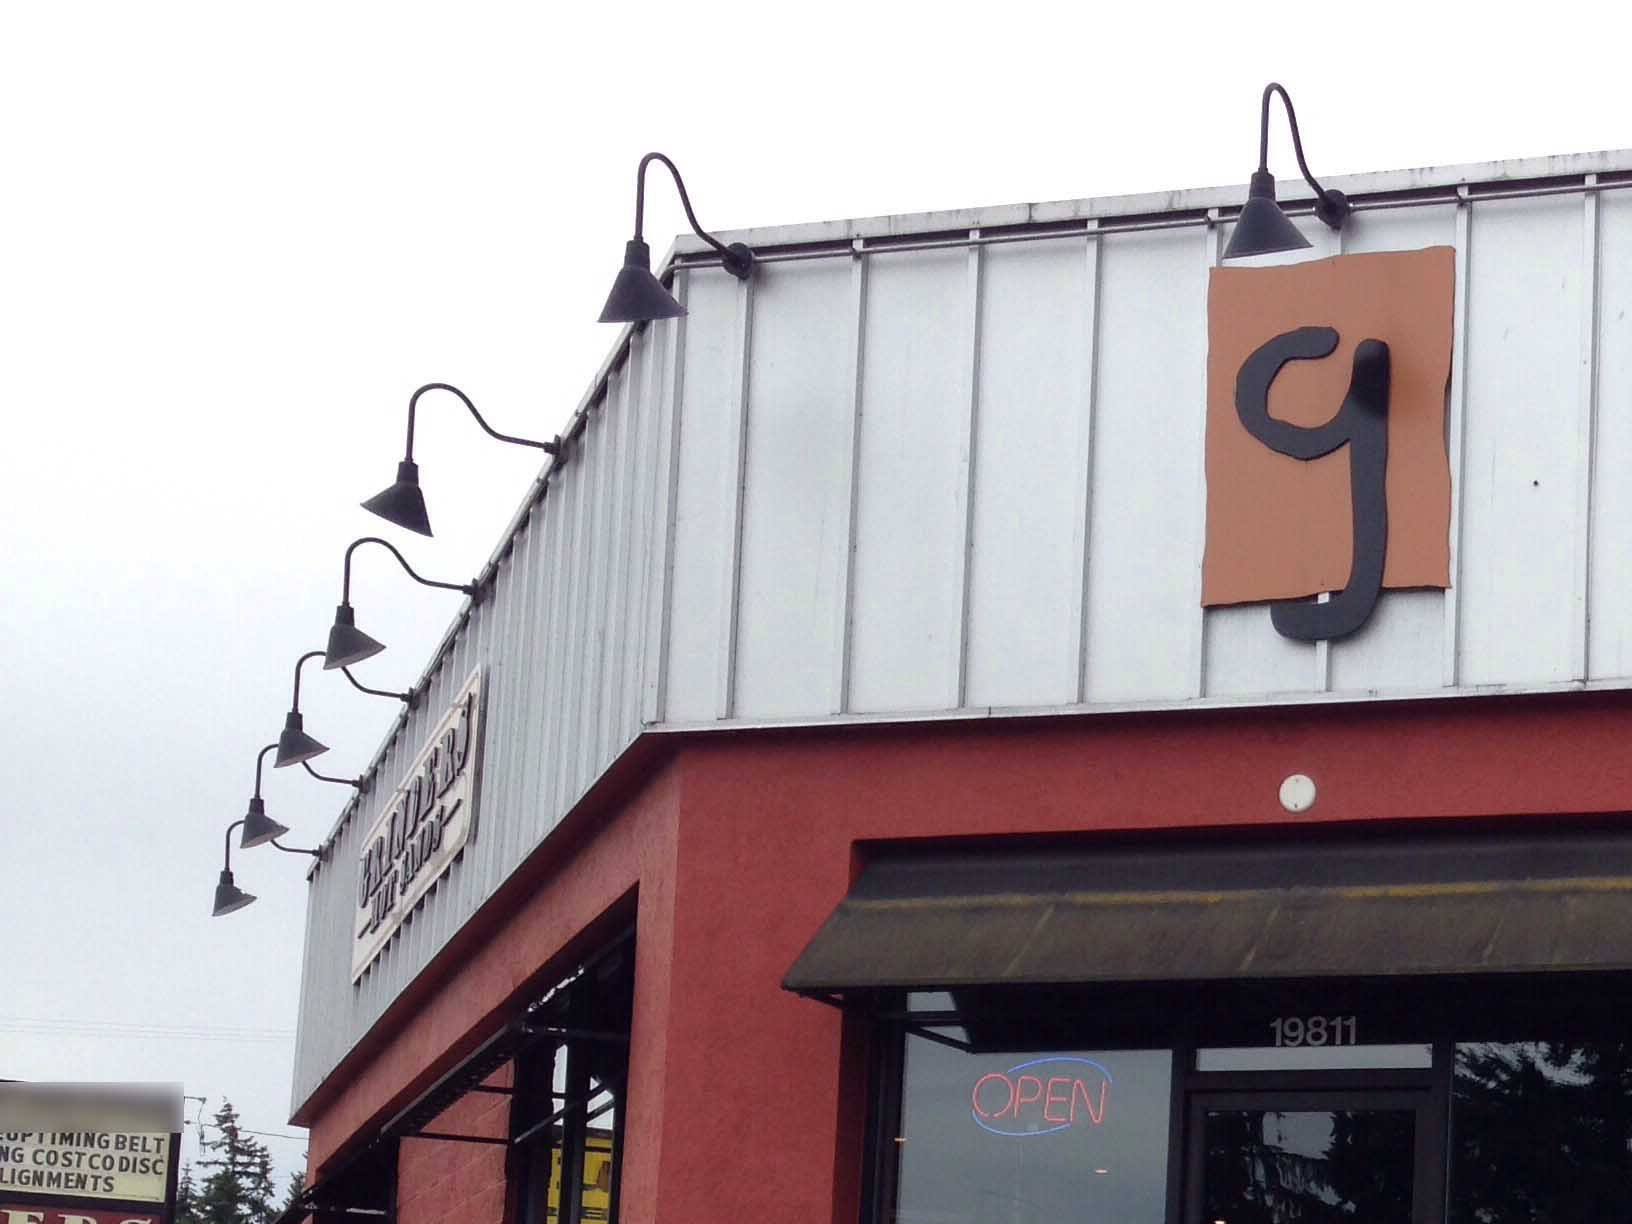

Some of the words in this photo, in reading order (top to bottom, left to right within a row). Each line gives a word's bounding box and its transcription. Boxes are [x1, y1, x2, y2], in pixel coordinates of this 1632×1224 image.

[1270, 1016, 1357, 1047] 19811
[972, 1073, 1108, 1125] OPEN
[114, 1135, 165, 1154] BELT
[32, 1149, 114, 1171] COSTCO
[118, 1156, 165, 1176] DISC
